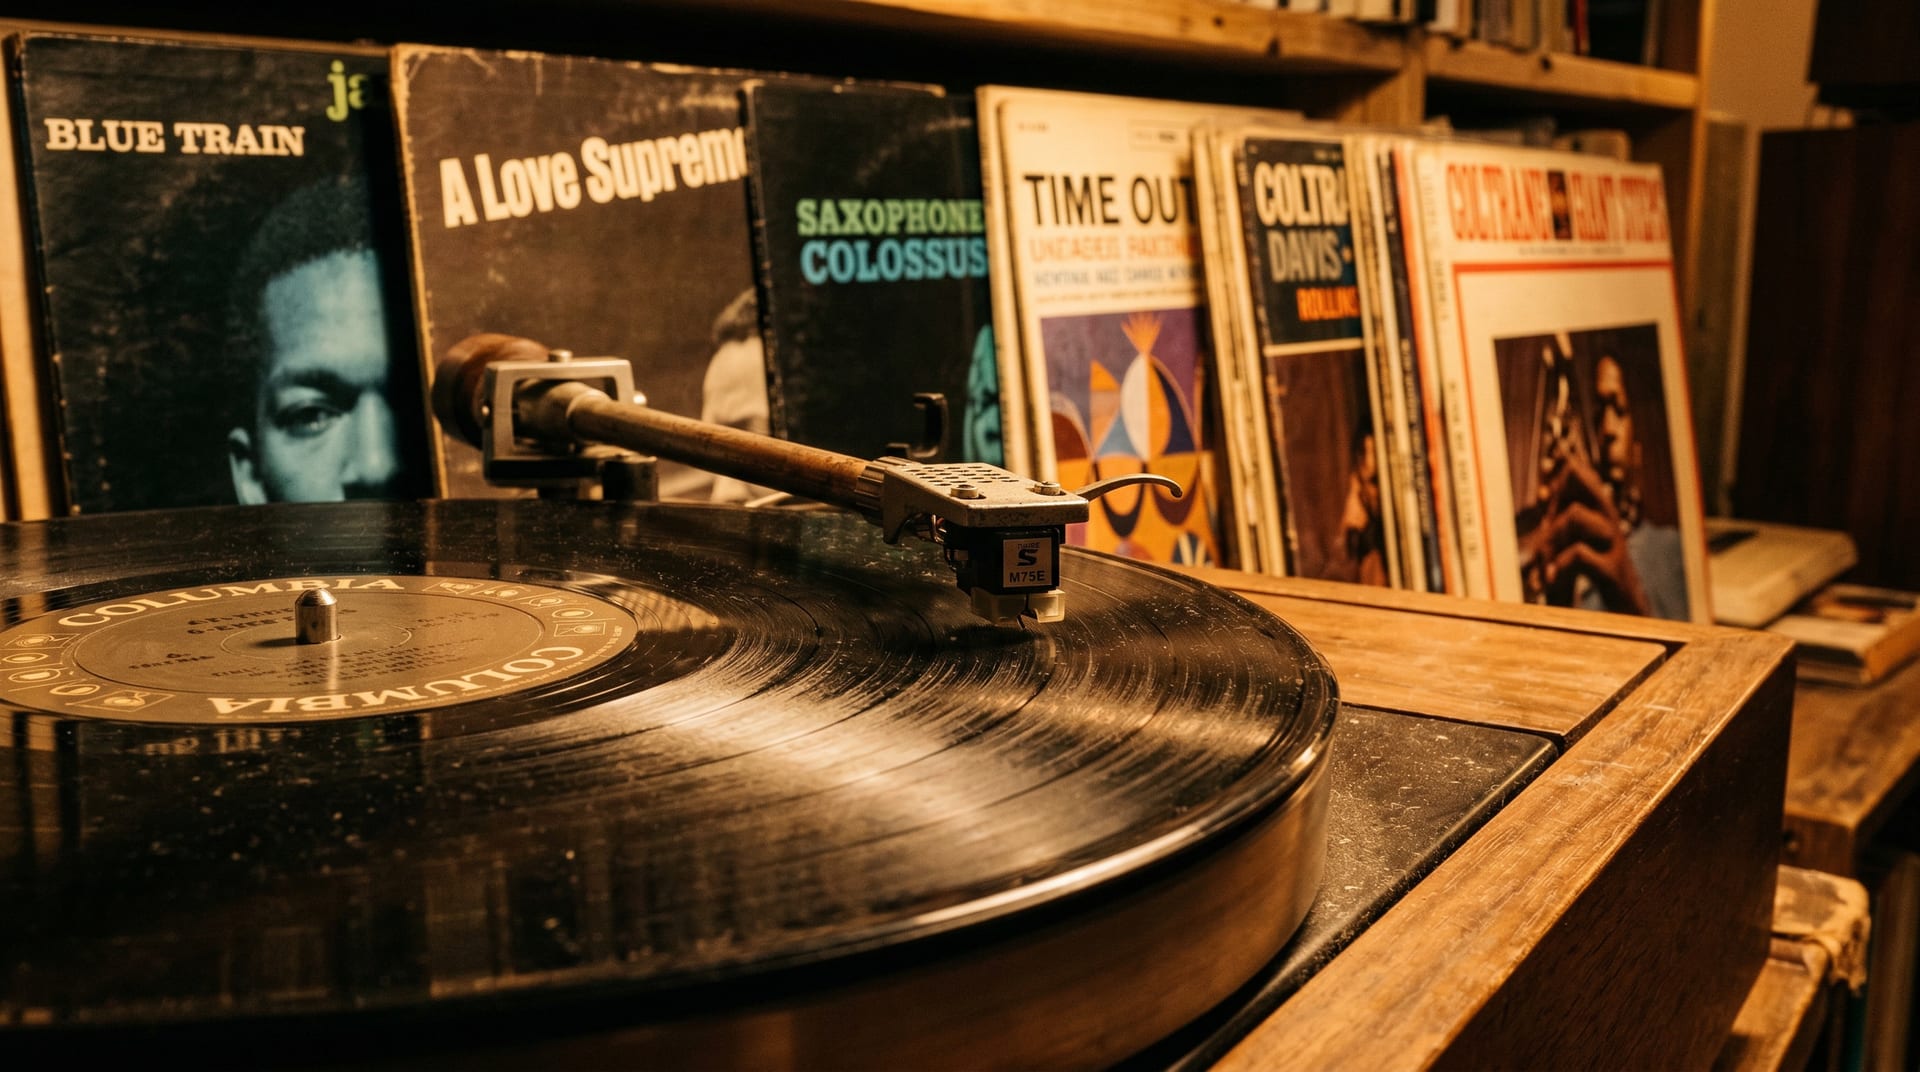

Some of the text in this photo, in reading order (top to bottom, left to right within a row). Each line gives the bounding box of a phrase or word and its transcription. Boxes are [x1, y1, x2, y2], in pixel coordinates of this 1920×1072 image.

[44, 118, 305, 156] BLUE TRAIN
[440, 158, 478, 228] A
[474, 152, 582, 222] Love
[1024, 174, 1120, 226] TIME
[796, 199, 985, 235] SAXOPHONE
[801, 238, 988, 284] COLOSSUS
[1267, 229, 1342, 283] DAVIS
[1009, 570, 1046, 583] M75E
[58, 578, 404, 627] COLUMBIA
[208, 646, 584, 713] COLUMBIA
